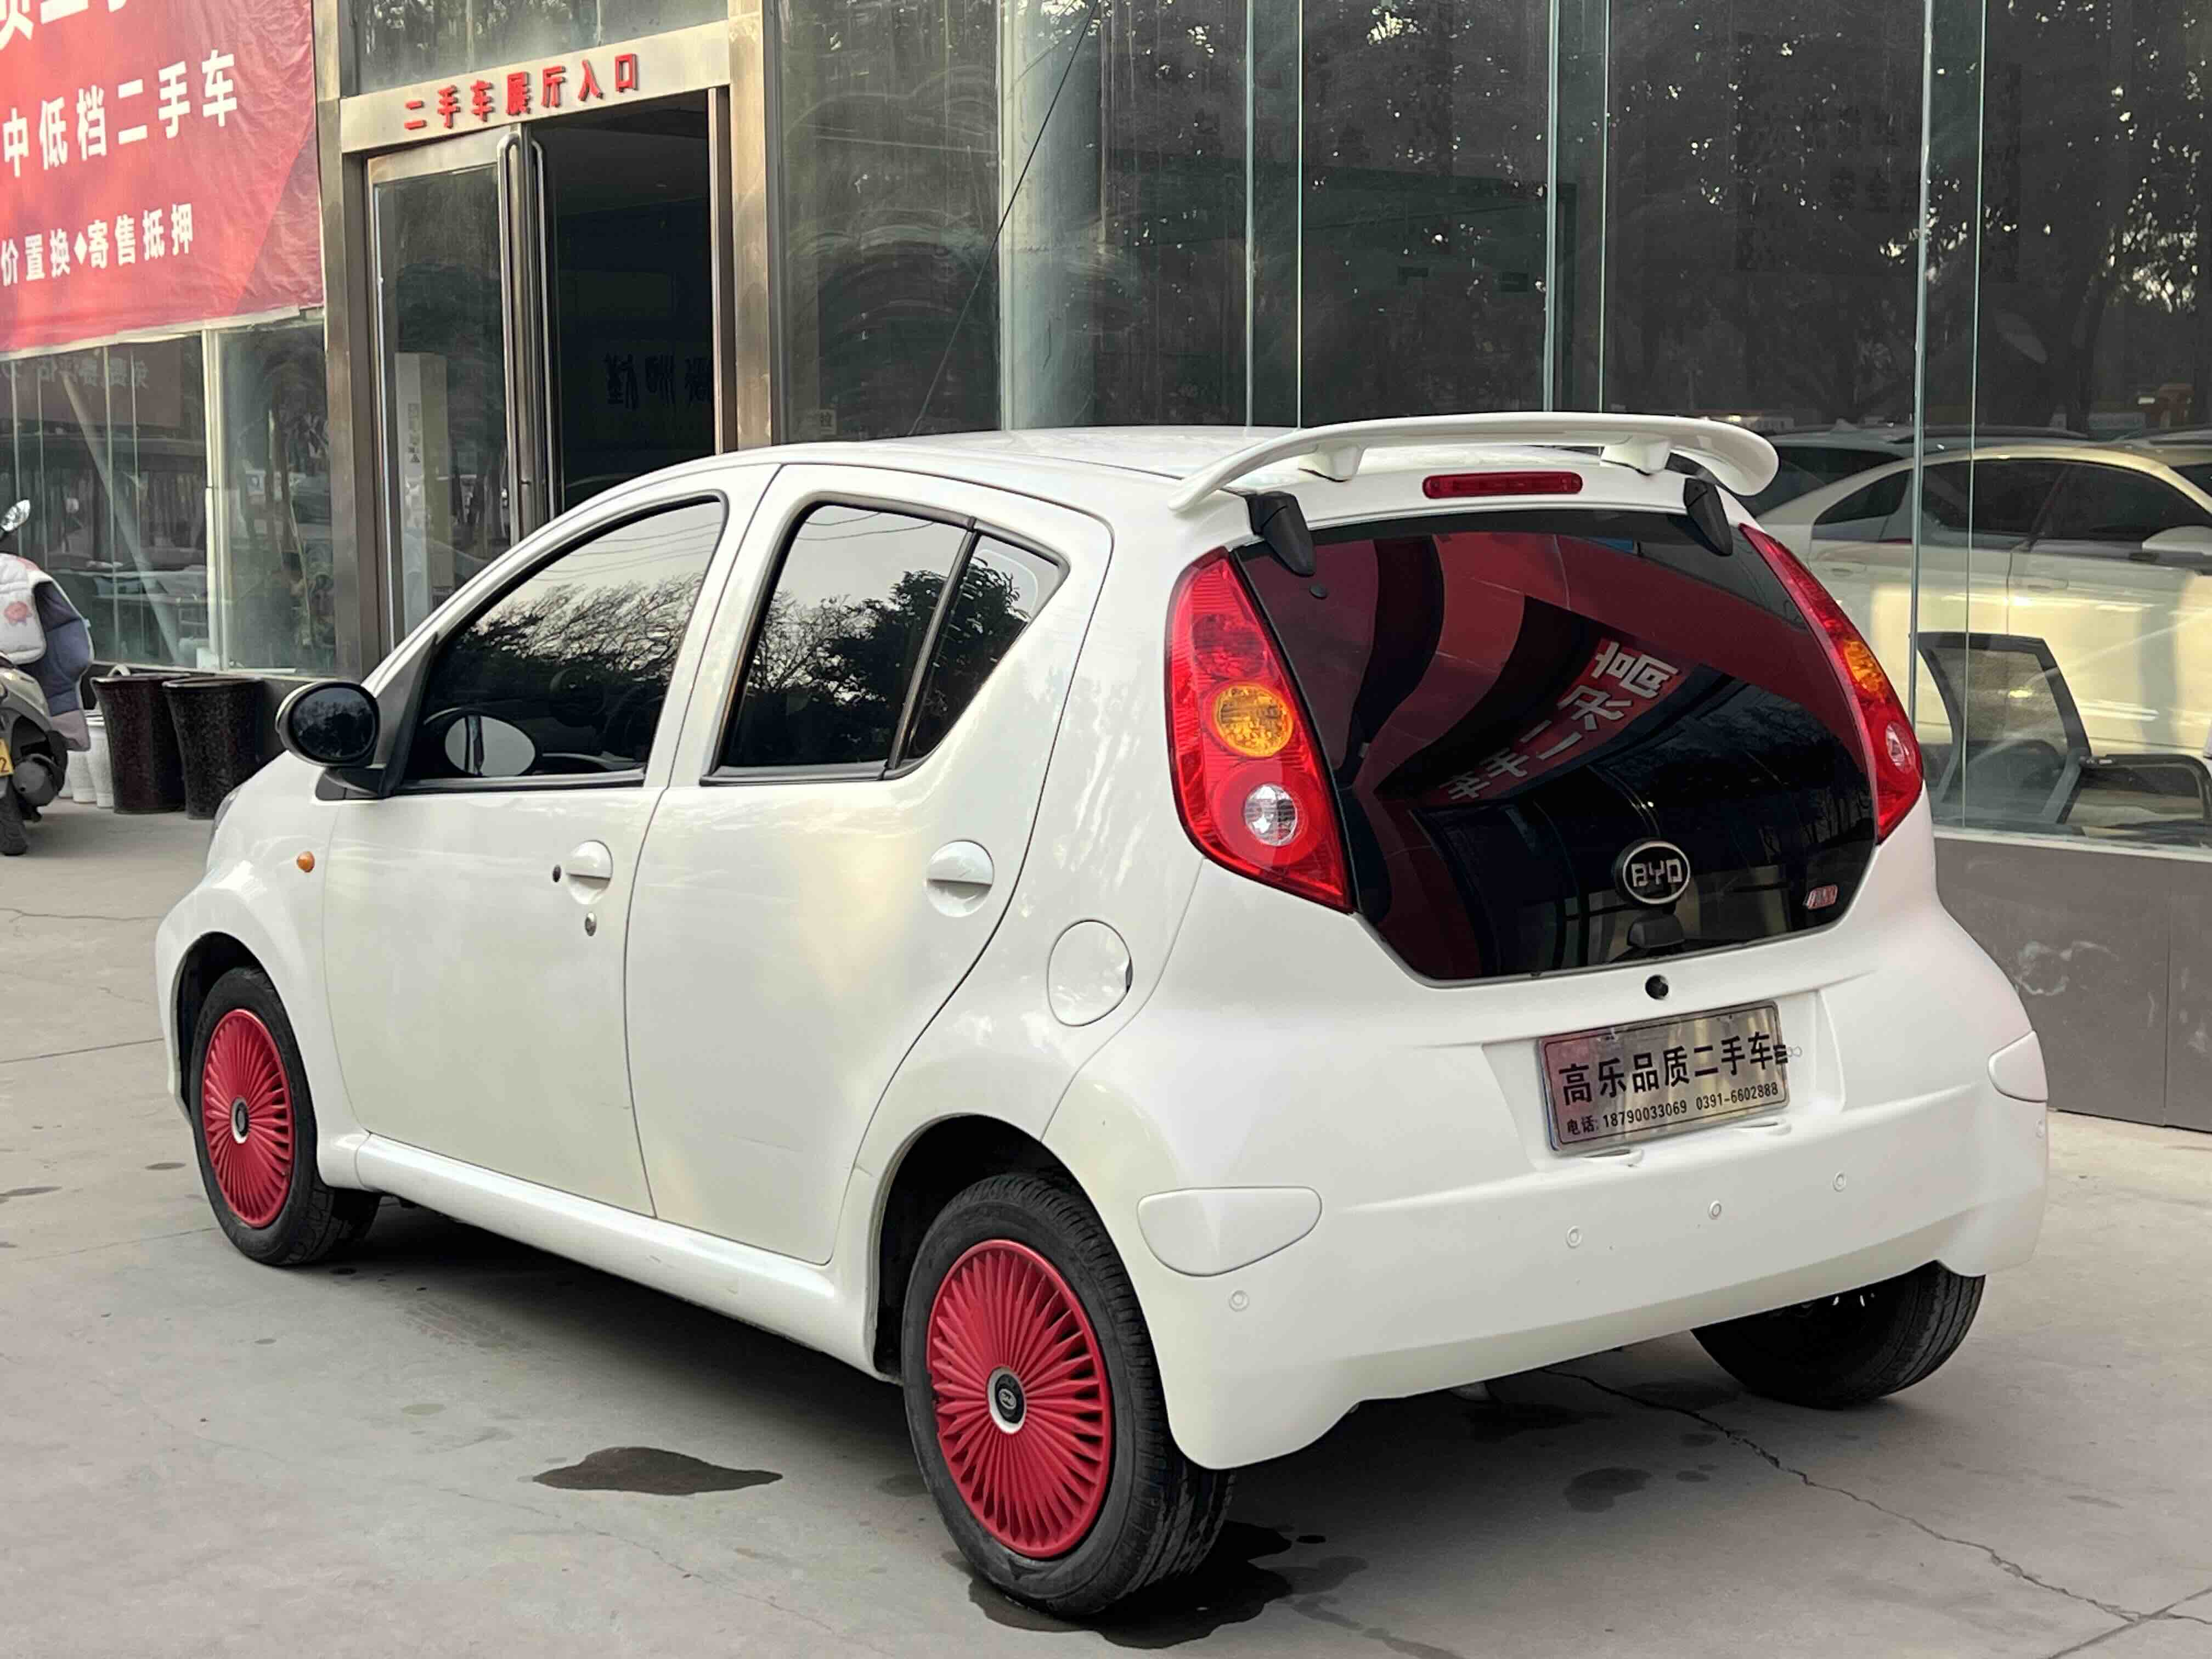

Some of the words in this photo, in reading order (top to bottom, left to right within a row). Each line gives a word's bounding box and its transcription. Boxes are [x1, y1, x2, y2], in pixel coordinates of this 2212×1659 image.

[3, 49, 238, 177] 中低档二手车
[404, 53, 639, 129] 二手车展厅入口
[1630, 858, 1684, 887] BYD
[1559, 1031, 1774, 1106] 高乐品质二手车
[1603, 1099, 1688, 1128] 18790033069
[1696, 1081, 1779, 1111] 0391-6602888
